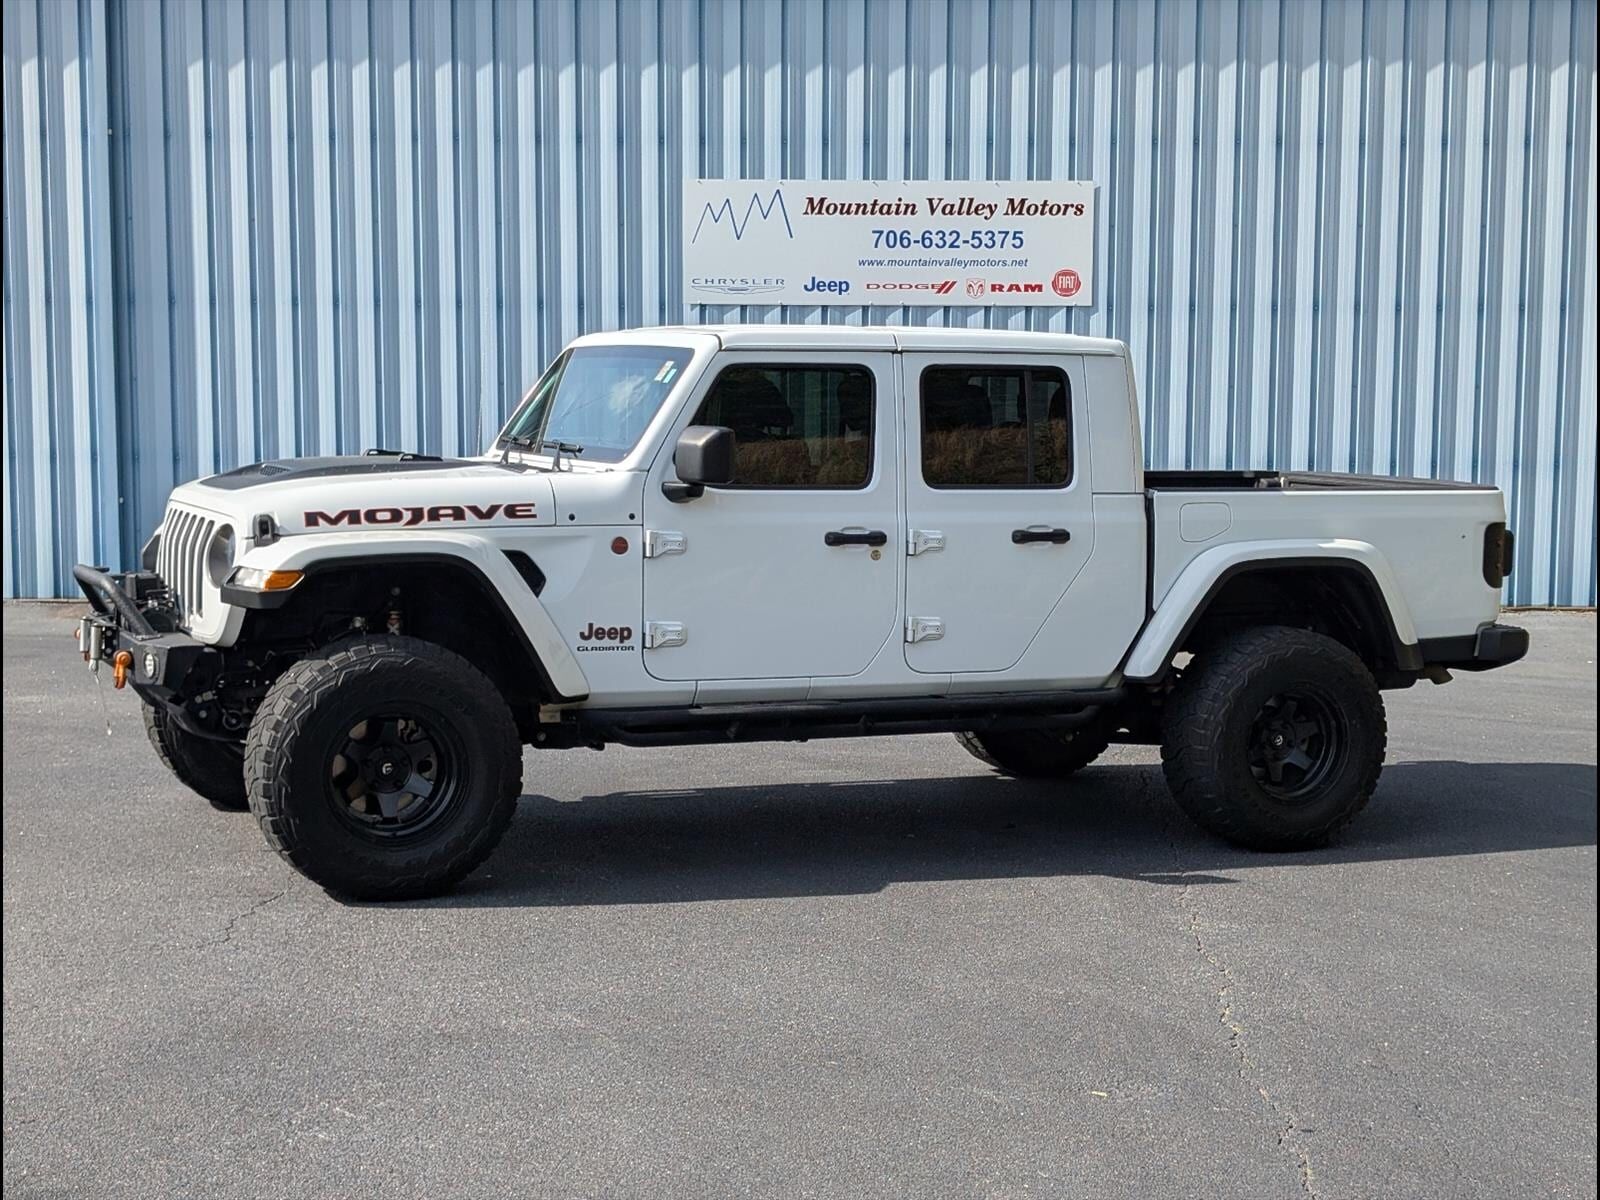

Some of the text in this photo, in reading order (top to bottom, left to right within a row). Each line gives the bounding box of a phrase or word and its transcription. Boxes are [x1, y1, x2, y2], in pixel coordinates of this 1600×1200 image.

[803, 197, 1085, 221] Mountain Valley Motors
[872, 230, 1024, 249] 706-632-5375
[858, 257, 1028, 269] www.mountainvalleymotors.net
[803, 276, 850, 295] Jeep
[990, 283, 1043, 293] RAM
[1058, 275, 1076, 287] FIAT
[304, 502, 537, 527] MOJAVE
[579, 622, 633, 644] Jeep
